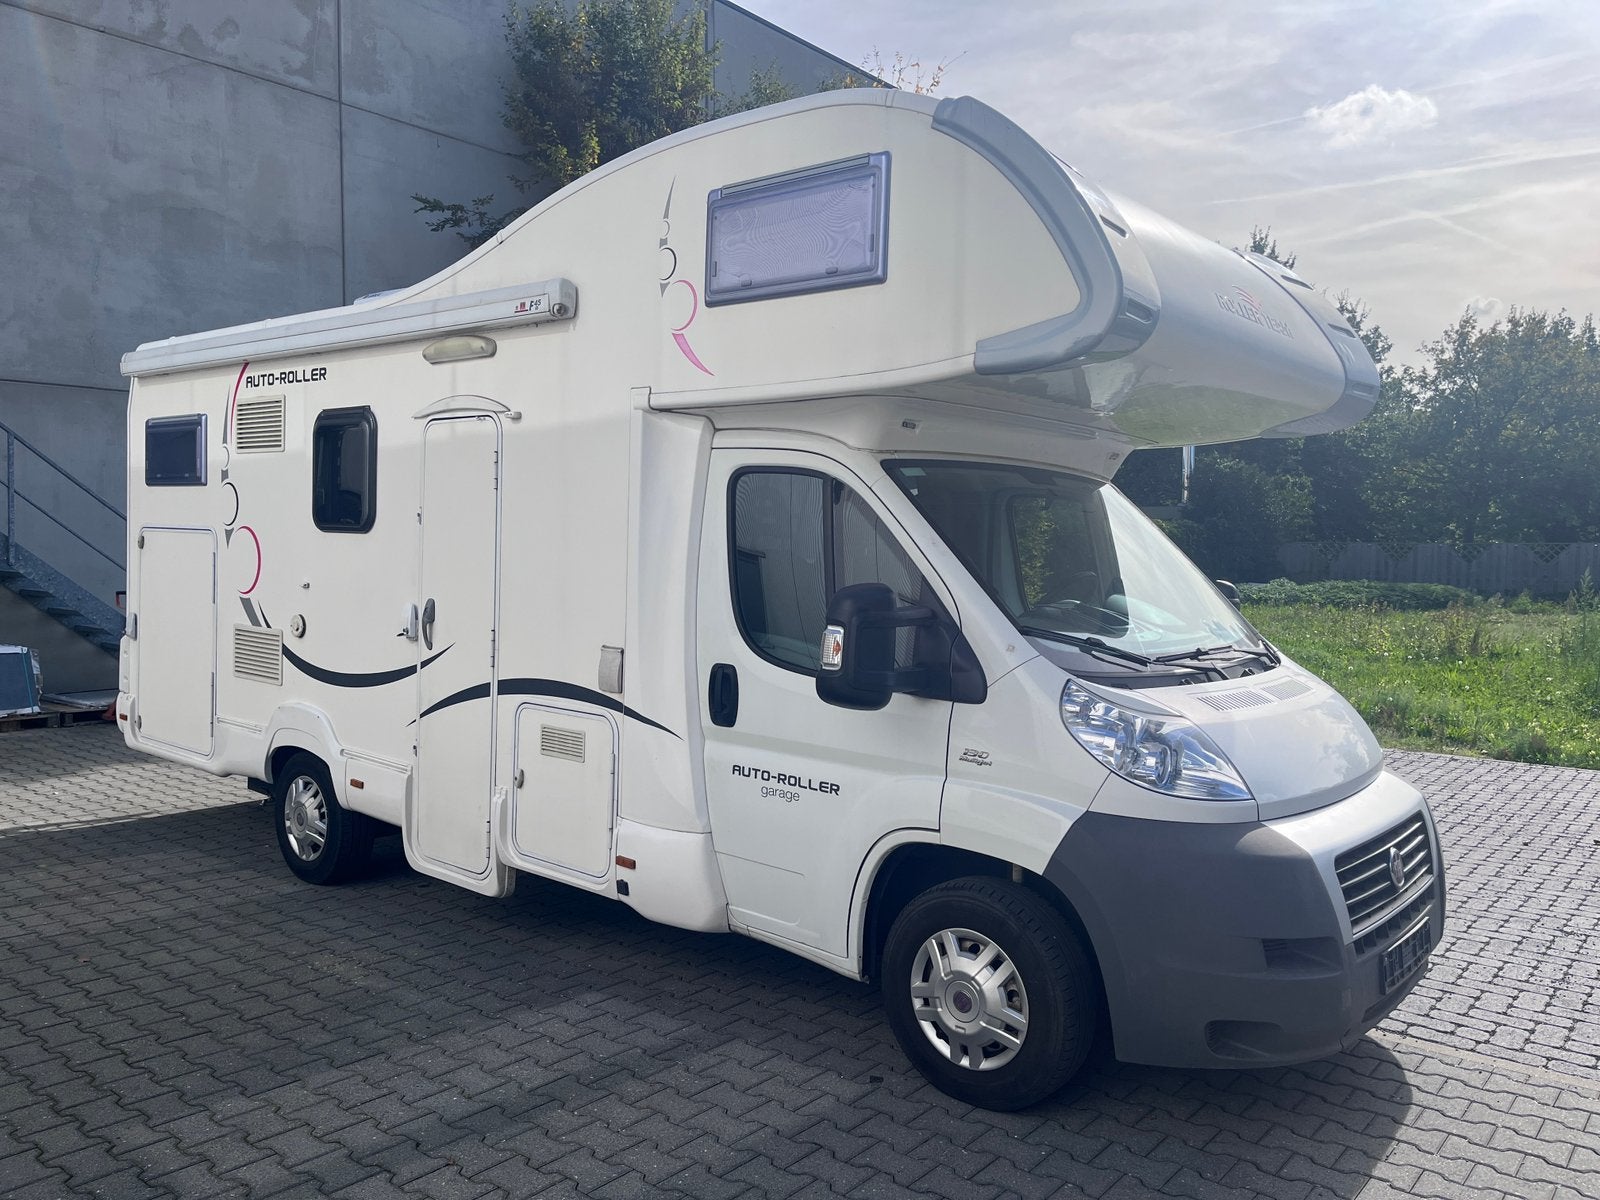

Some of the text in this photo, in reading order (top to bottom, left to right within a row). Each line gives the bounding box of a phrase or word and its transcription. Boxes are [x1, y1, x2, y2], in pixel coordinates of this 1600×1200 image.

[245, 367, 327, 388] AUTO-ROLLER
[732, 764, 841, 796] AUTO-ROLLER
[760, 785, 800, 803] garage
